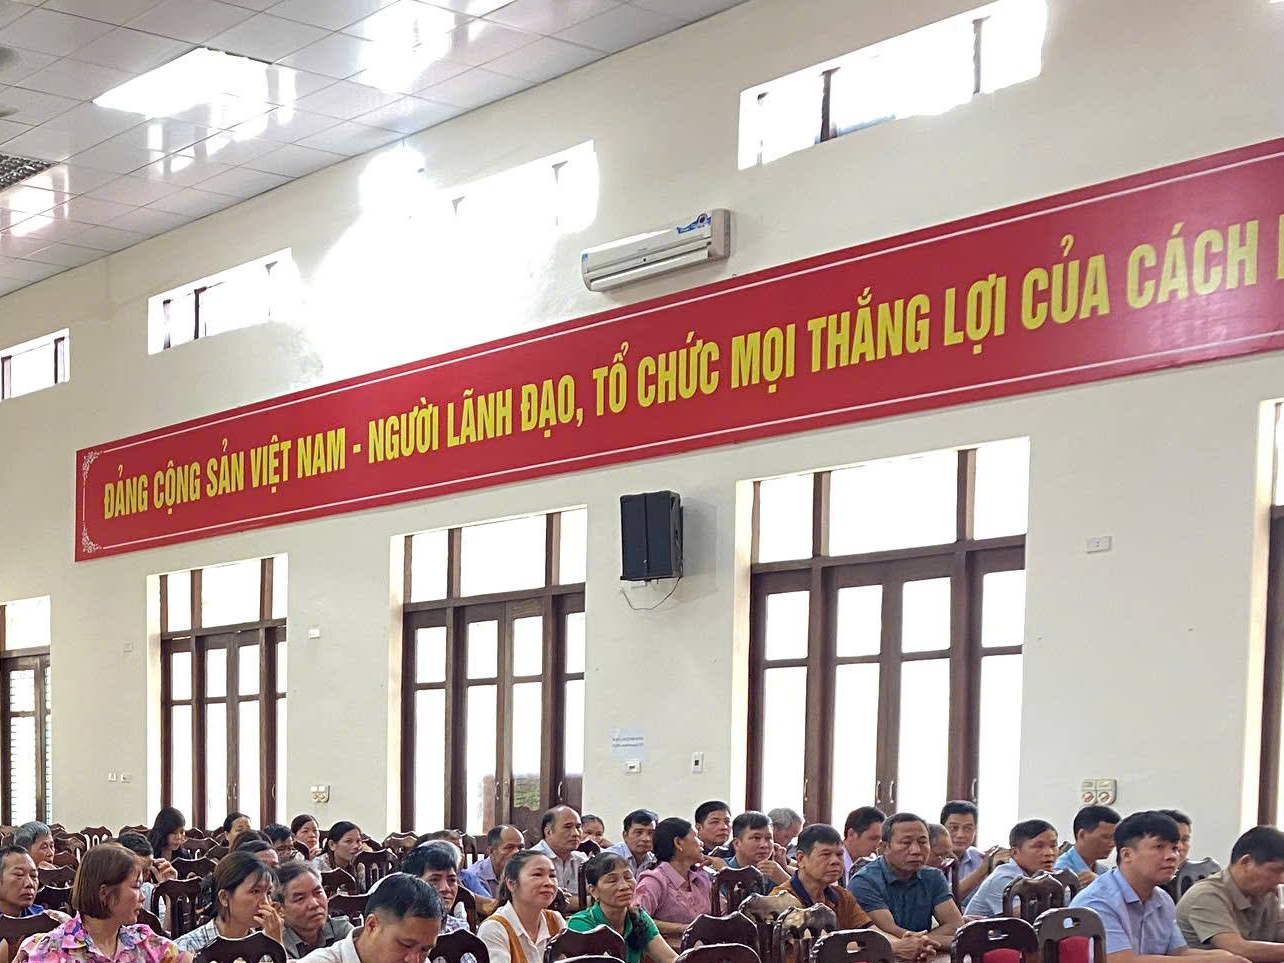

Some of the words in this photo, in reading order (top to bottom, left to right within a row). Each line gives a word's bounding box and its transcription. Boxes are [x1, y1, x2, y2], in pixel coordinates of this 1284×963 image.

[104, 464, 149, 519] ĐẢNG
[153, 460, 201, 515] CỘNG
[206, 438, 245, 497] SẢN
[250, 435, 292, 494] VIỆT
[297, 427, 346, 479] NAM
[368, 399, 439, 464] NGƯỜI
[447, 388, 513, 448] LÃNH
[520, 374, 583, 438] ĐẠO,
[592, 341, 628, 417] TỔ
[637, 332, 720, 408] CHỨC
[731, 323, 796, 394] MỌI
[806, 286, 931, 373] THẮNG
[943, 273, 1007, 355] LỢI
[1021, 234, 1110, 331] CỦA
[1126, 219, 1259, 309] CÁCH
